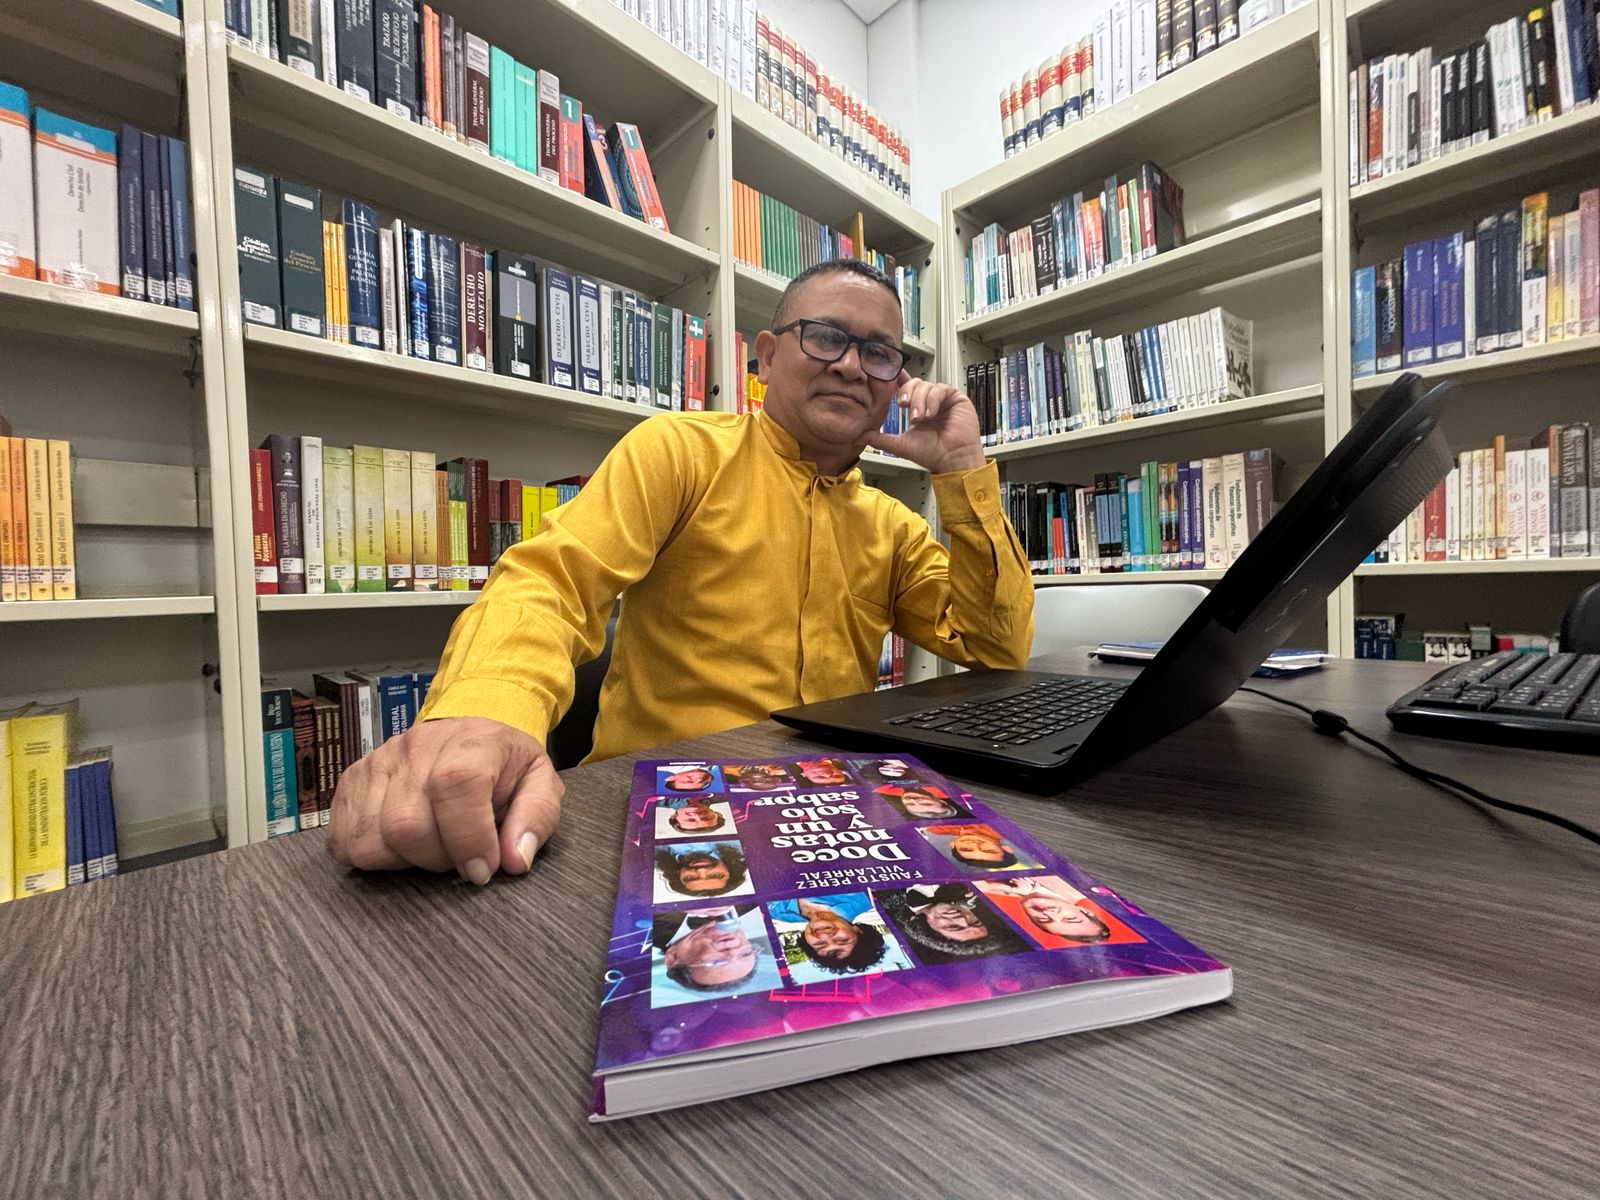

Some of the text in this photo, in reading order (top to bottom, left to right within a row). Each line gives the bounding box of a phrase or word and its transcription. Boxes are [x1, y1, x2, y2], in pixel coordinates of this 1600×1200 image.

[242, 242, 271, 253] General
[243, 236, 269, 248] Código
[467, 274, 476, 323] DERECHO
[477, 272, 485, 332] MONETARIO
[392, 705, 400, 735] ENERAL
[753, 791, 860, 806] sabor
[781, 804, 861, 821] solo
[775, 815, 873, 834] y un
[770, 829, 893, 848] notas
[790, 843, 911, 863] Doce
[795, 870, 923, 889] FAUSTO PÉREZ
[800, 865, 904, 880] VILLARREAL
